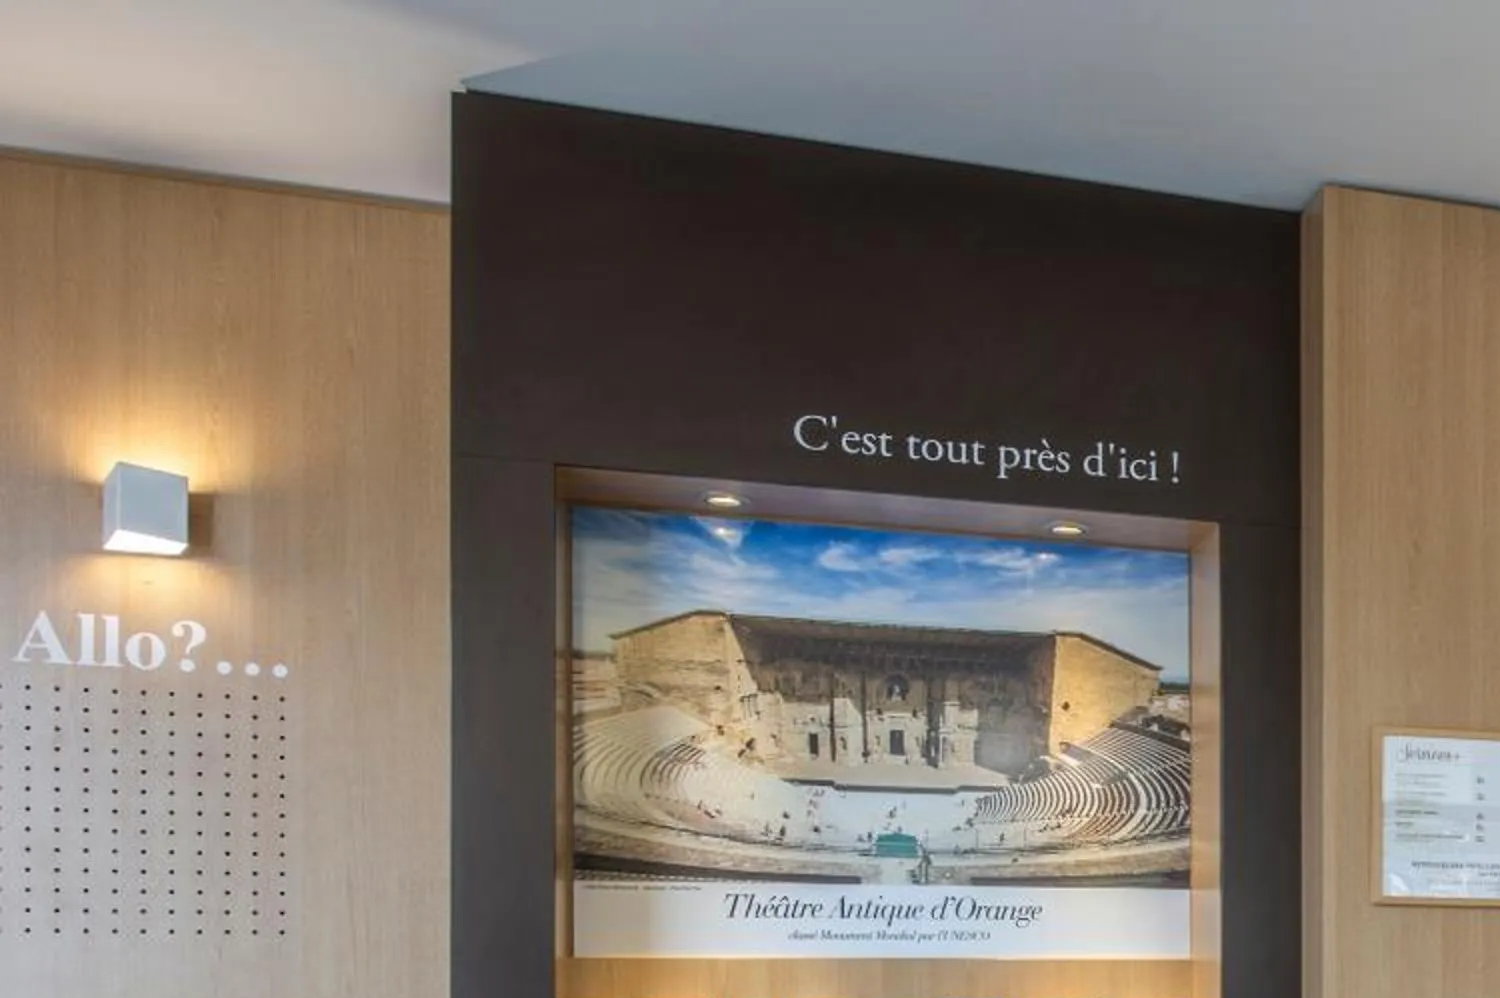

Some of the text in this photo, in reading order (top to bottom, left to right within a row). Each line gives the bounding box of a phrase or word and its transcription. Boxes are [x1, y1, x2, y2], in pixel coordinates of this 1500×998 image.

[793, 414, 893, 457] C'est
[906, 434, 985, 465] tout
[996, 438, 1071, 479] près
[1083, 442, 1159, 481] d'ici
[724, 893, 1043, 928] Théâtre Antique d'Orange
